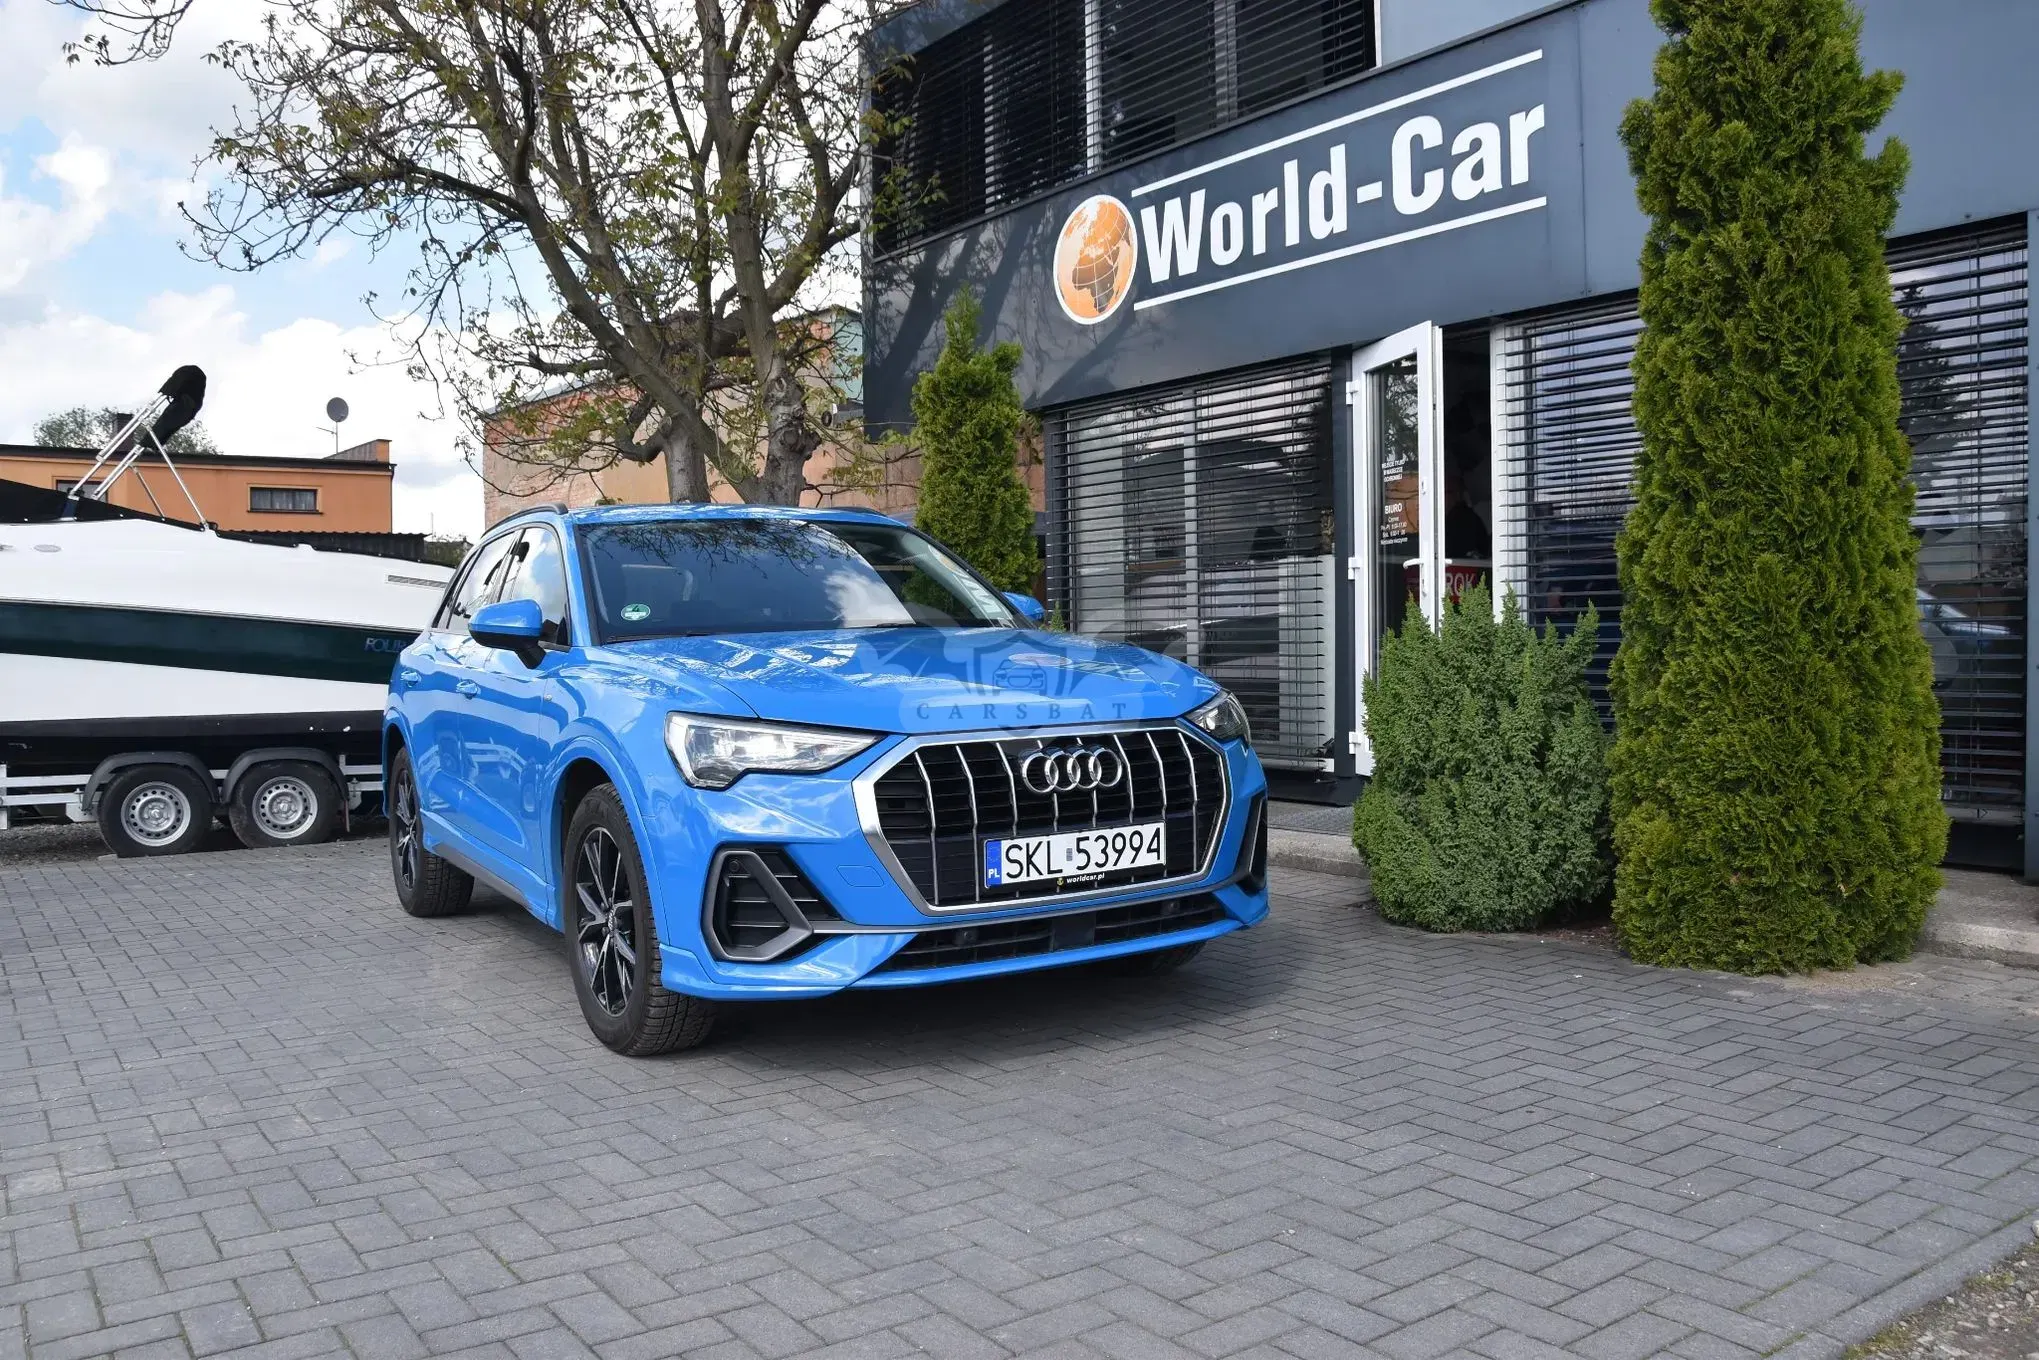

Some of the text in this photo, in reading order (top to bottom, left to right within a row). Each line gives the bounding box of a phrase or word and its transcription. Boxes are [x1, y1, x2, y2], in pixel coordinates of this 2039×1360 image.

[1140, 103, 1545, 284] World-Car
[1384, 503, 1403, 514] BIURO
[1005, 827, 1161, 879] SKL 53994
[988, 868, 1000, 879] PL
[1066, 873, 1105, 884] worldcar.pl
